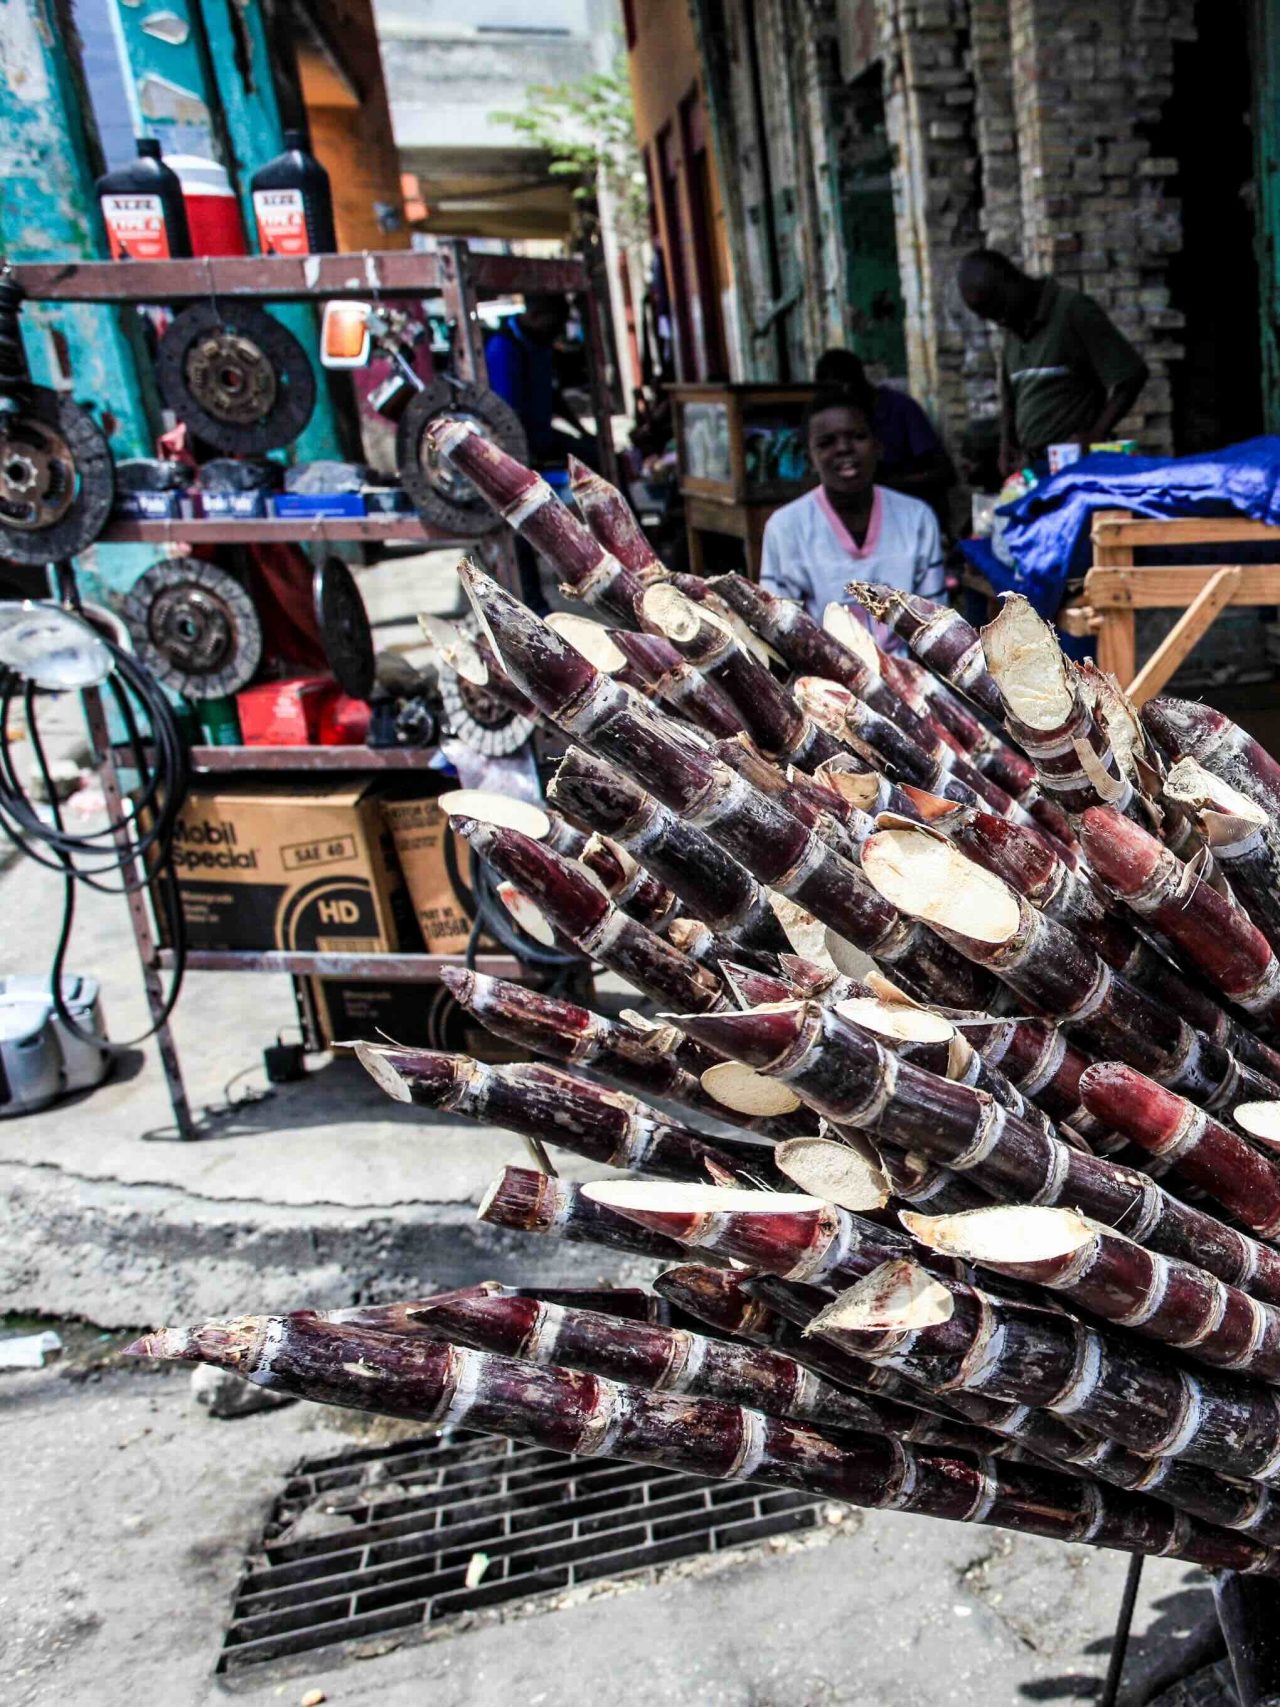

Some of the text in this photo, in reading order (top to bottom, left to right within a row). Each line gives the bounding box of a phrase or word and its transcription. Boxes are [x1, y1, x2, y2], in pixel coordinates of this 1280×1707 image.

[171, 846, 257, 871] Special
[295, 844, 345, 863] SAE 40
[317, 900, 360, 924] HD
